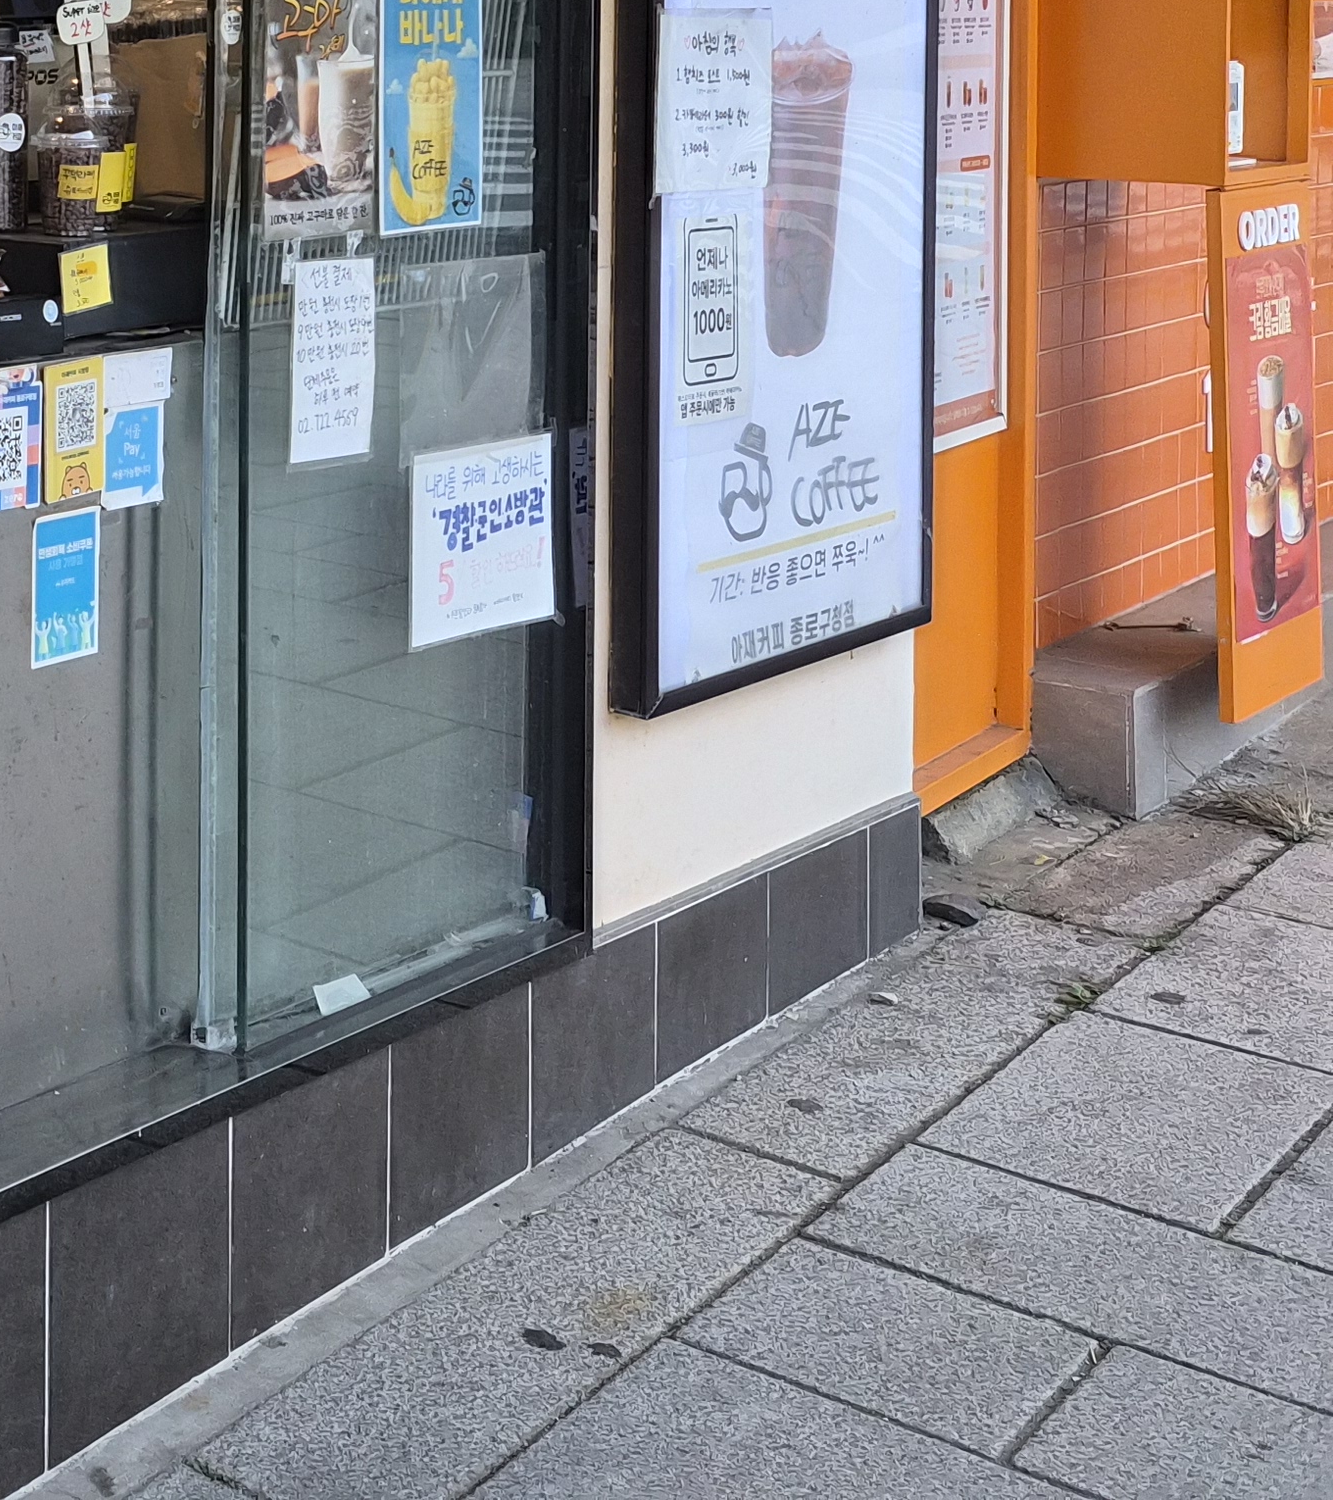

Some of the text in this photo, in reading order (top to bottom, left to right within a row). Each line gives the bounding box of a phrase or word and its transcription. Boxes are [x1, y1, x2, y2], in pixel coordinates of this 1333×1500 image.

[399, 9, 465, 45] 바나나
[692, 30, 720, 56] 아침의
[269, 214, 288, 226] 100%
[1239, 203, 1301, 251] ORDER
[696, 246, 729, 272] 언제나
[691, 277, 733, 300] 아메리카노
[693, 307, 733, 336] 1000원
[787, 398, 852, 463] AZE
[123, 441, 141, 458] Pay
[425, 466, 456, 500] 나라를
[462, 464, 486, 492] 위해
[491, 451, 545, 485] 고생하시는
[790, 456, 880, 528] COFFEE
[750, 561, 782, 597] 반응
[785, 550, 828, 588] 좋으면
[730, 619, 785, 665] 아재커피
